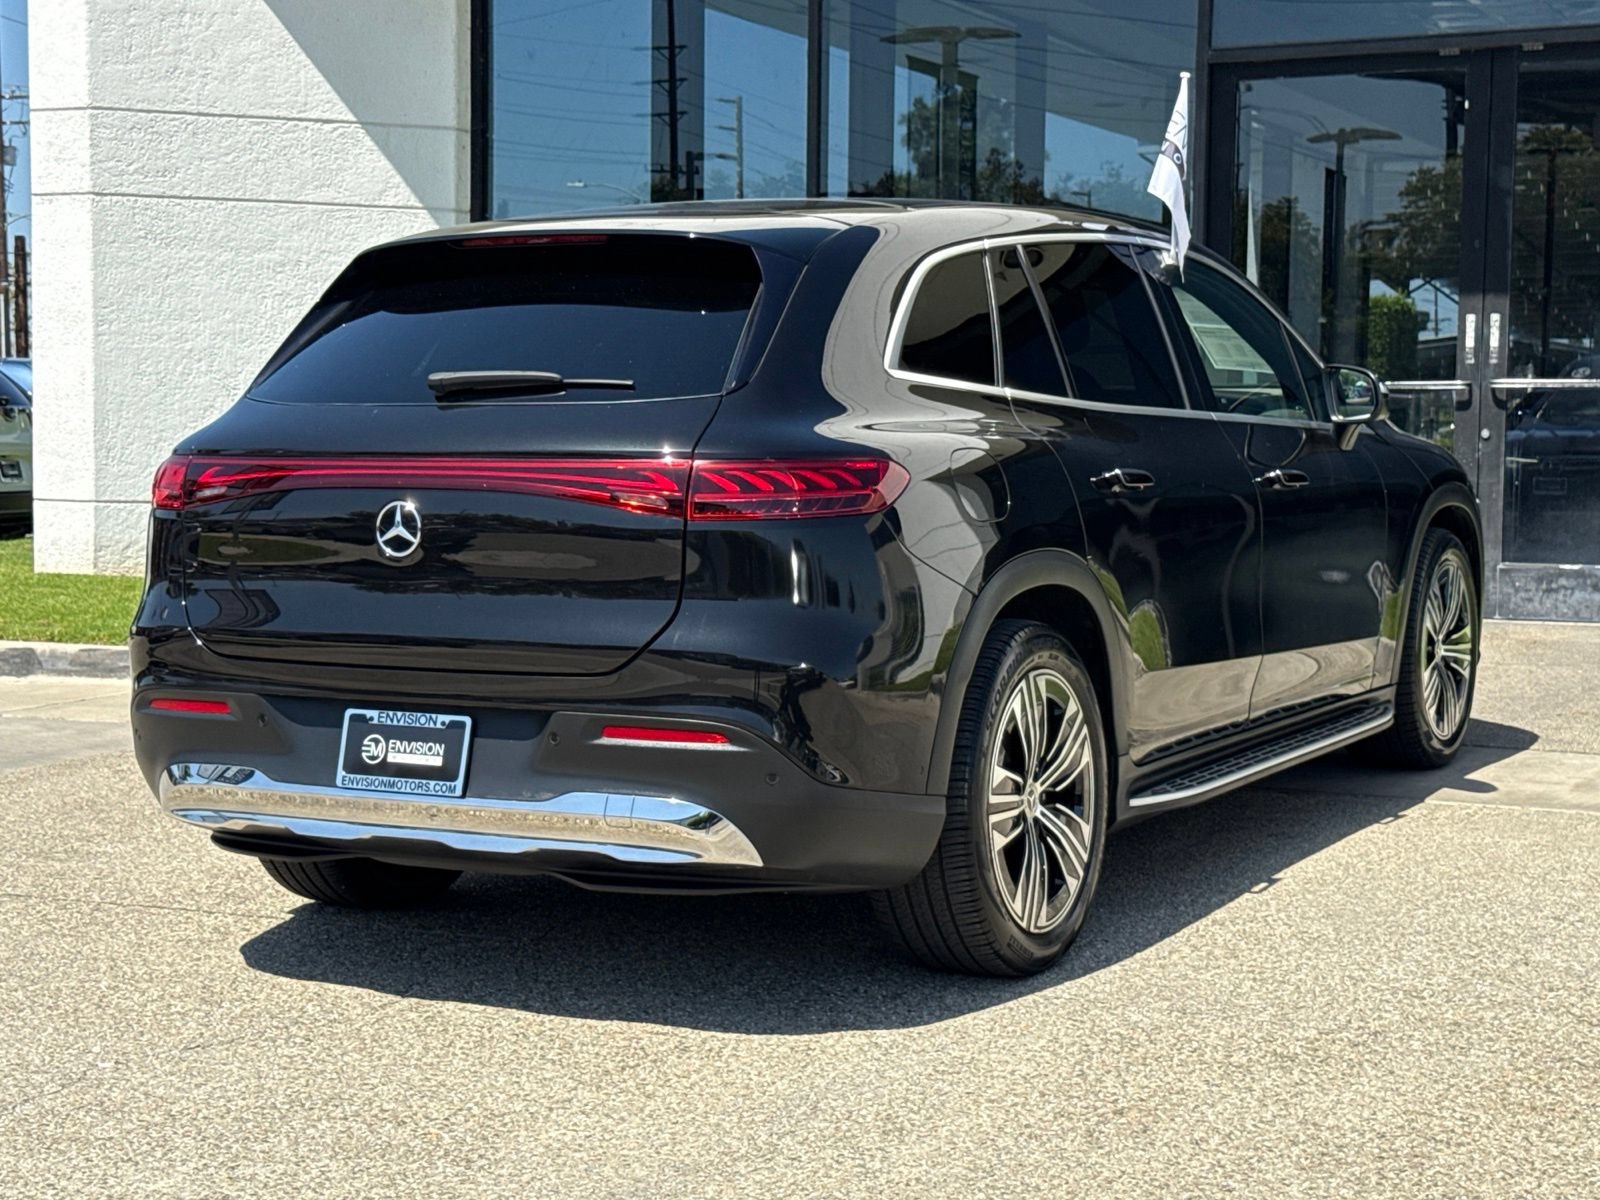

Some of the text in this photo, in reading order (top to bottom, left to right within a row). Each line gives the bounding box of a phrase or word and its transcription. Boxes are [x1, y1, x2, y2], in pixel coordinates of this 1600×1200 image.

[377, 711, 438, 727] ENVISION
[388, 739, 445, 756] ENVISION
[341, 775, 456, 794] ENVISIONMOTORS.COM
